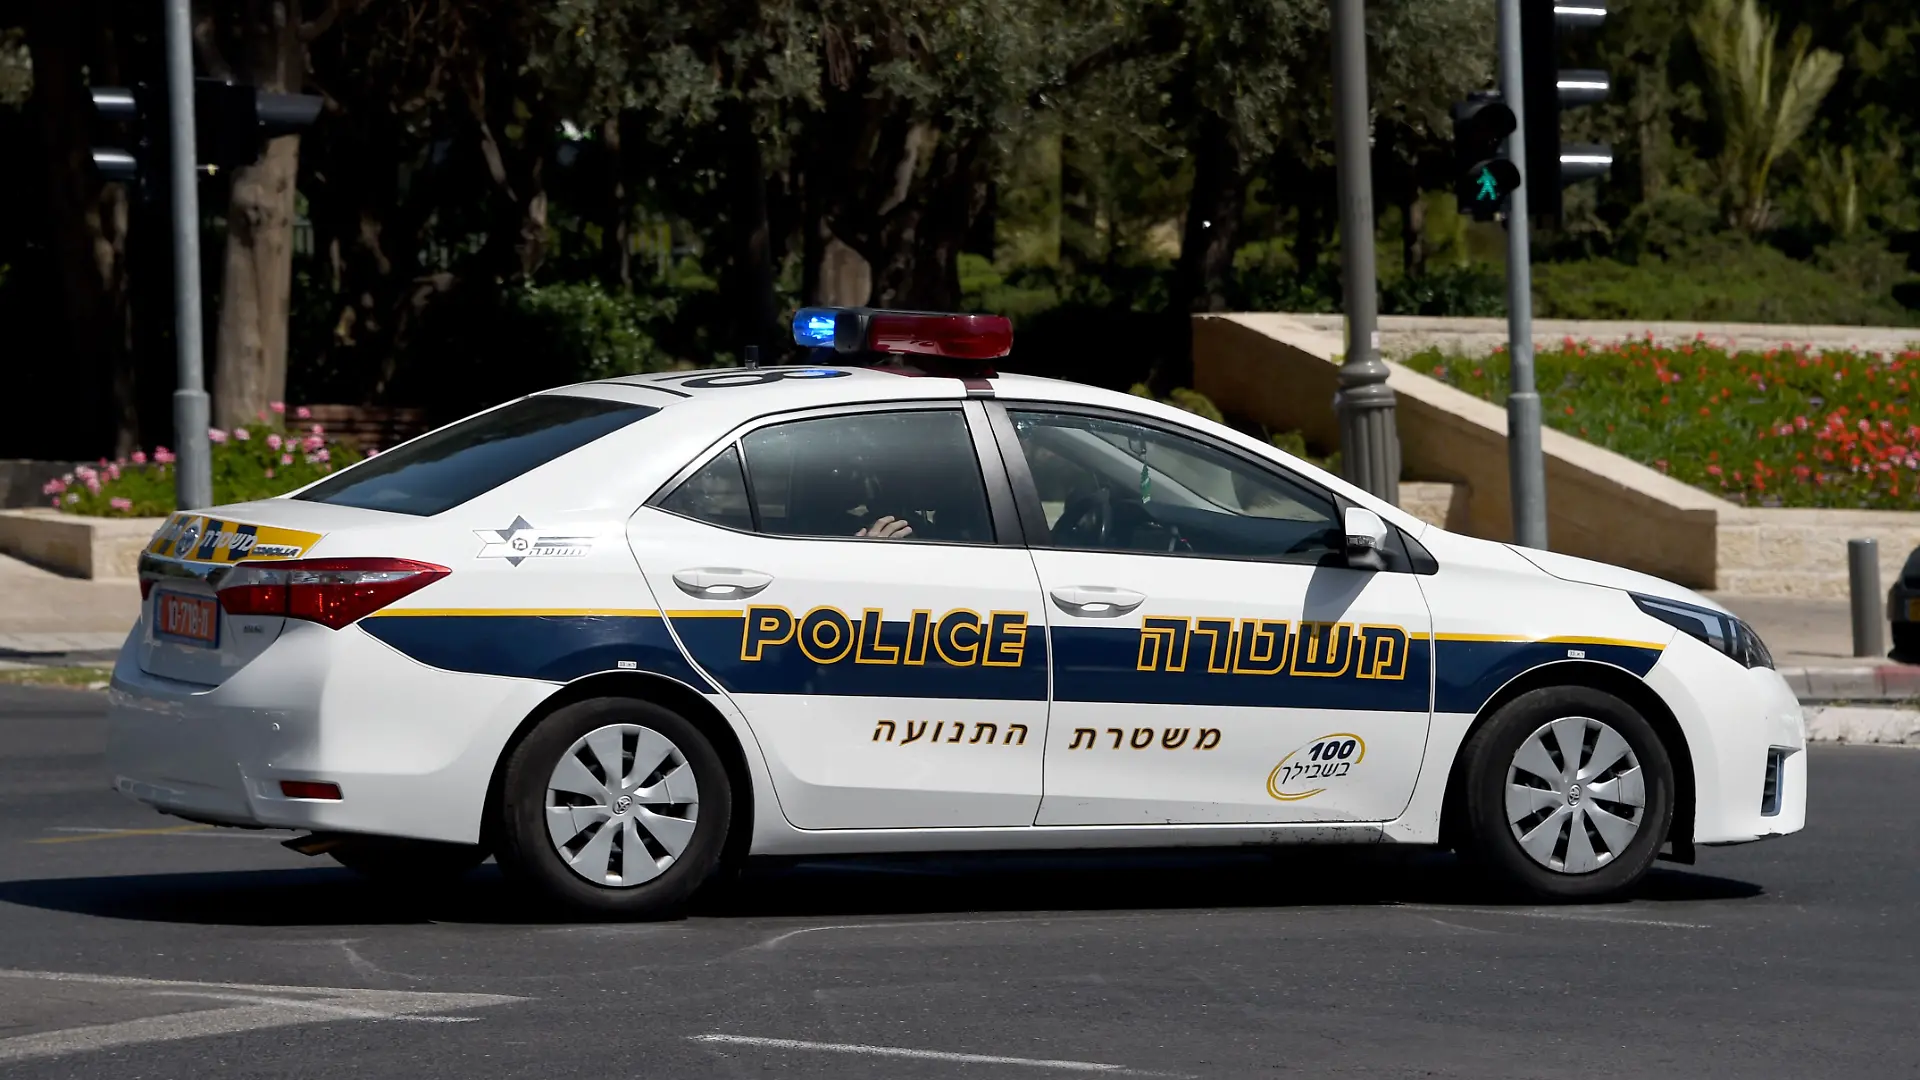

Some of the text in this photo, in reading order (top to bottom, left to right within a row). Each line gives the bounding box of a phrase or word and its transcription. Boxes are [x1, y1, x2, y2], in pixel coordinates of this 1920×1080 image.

[740, 604, 1028, 667] POLICE
[1136, 615, 1410, 681] משטרה
[872, 719, 1222, 750] משטרת התנועה
[1308, 739, 1357, 761] 100
[1281, 762, 1351, 785] בשבילך
